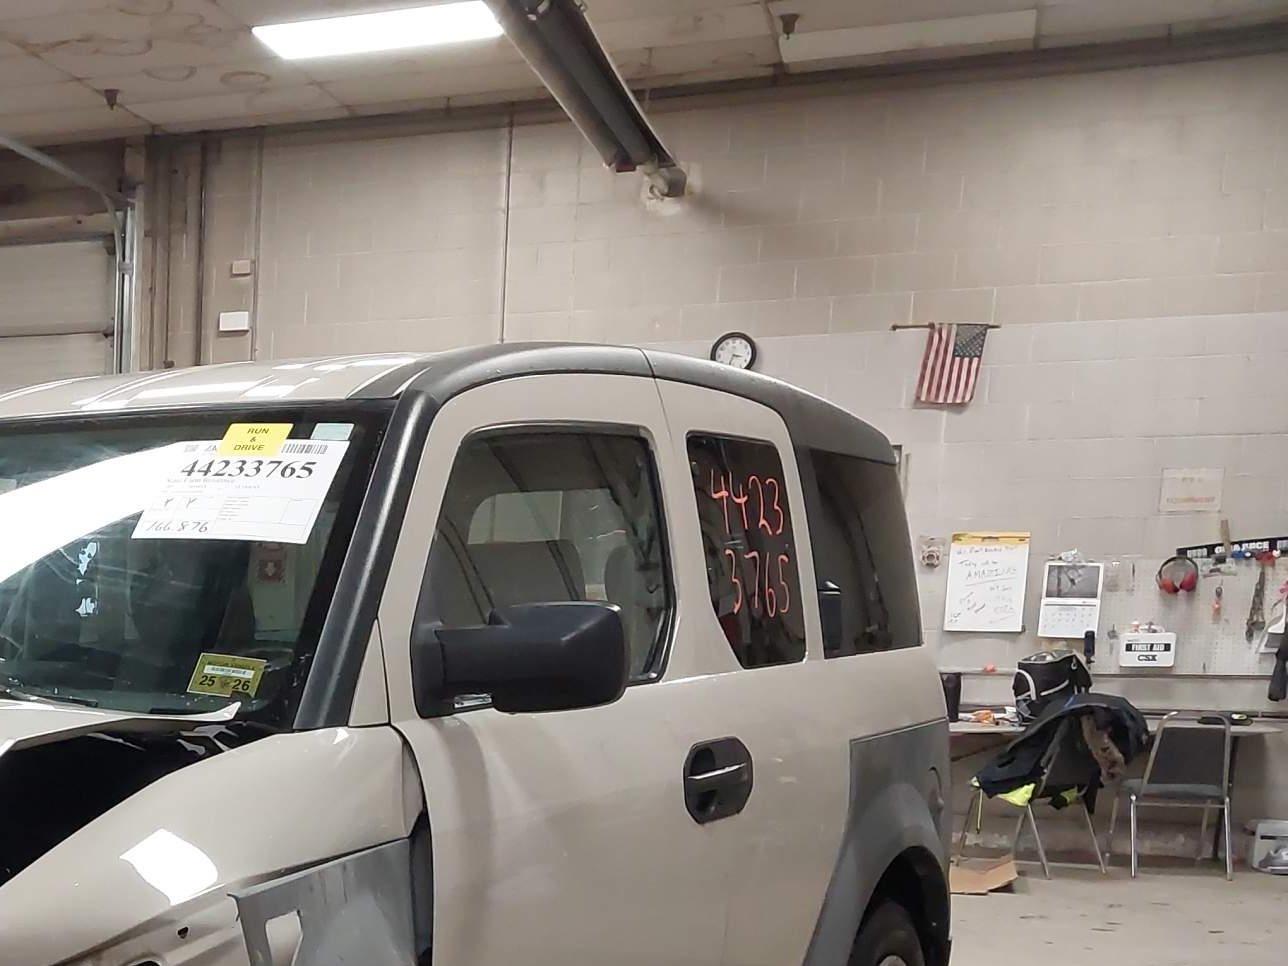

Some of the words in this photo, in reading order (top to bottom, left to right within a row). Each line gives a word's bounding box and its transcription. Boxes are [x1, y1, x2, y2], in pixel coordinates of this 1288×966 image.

[247, 427, 269, 435] RUN
[180, 459, 318, 479] 44233765
[712, 468, 784, 536] 4423
[725, 549, 790, 618] 3765
[1132, 643, 1150, 652] FIRST
[1153, 643, 1165, 652] AID
[199, 675, 217, 687] 25
[232, 679, 251, 691] 26
